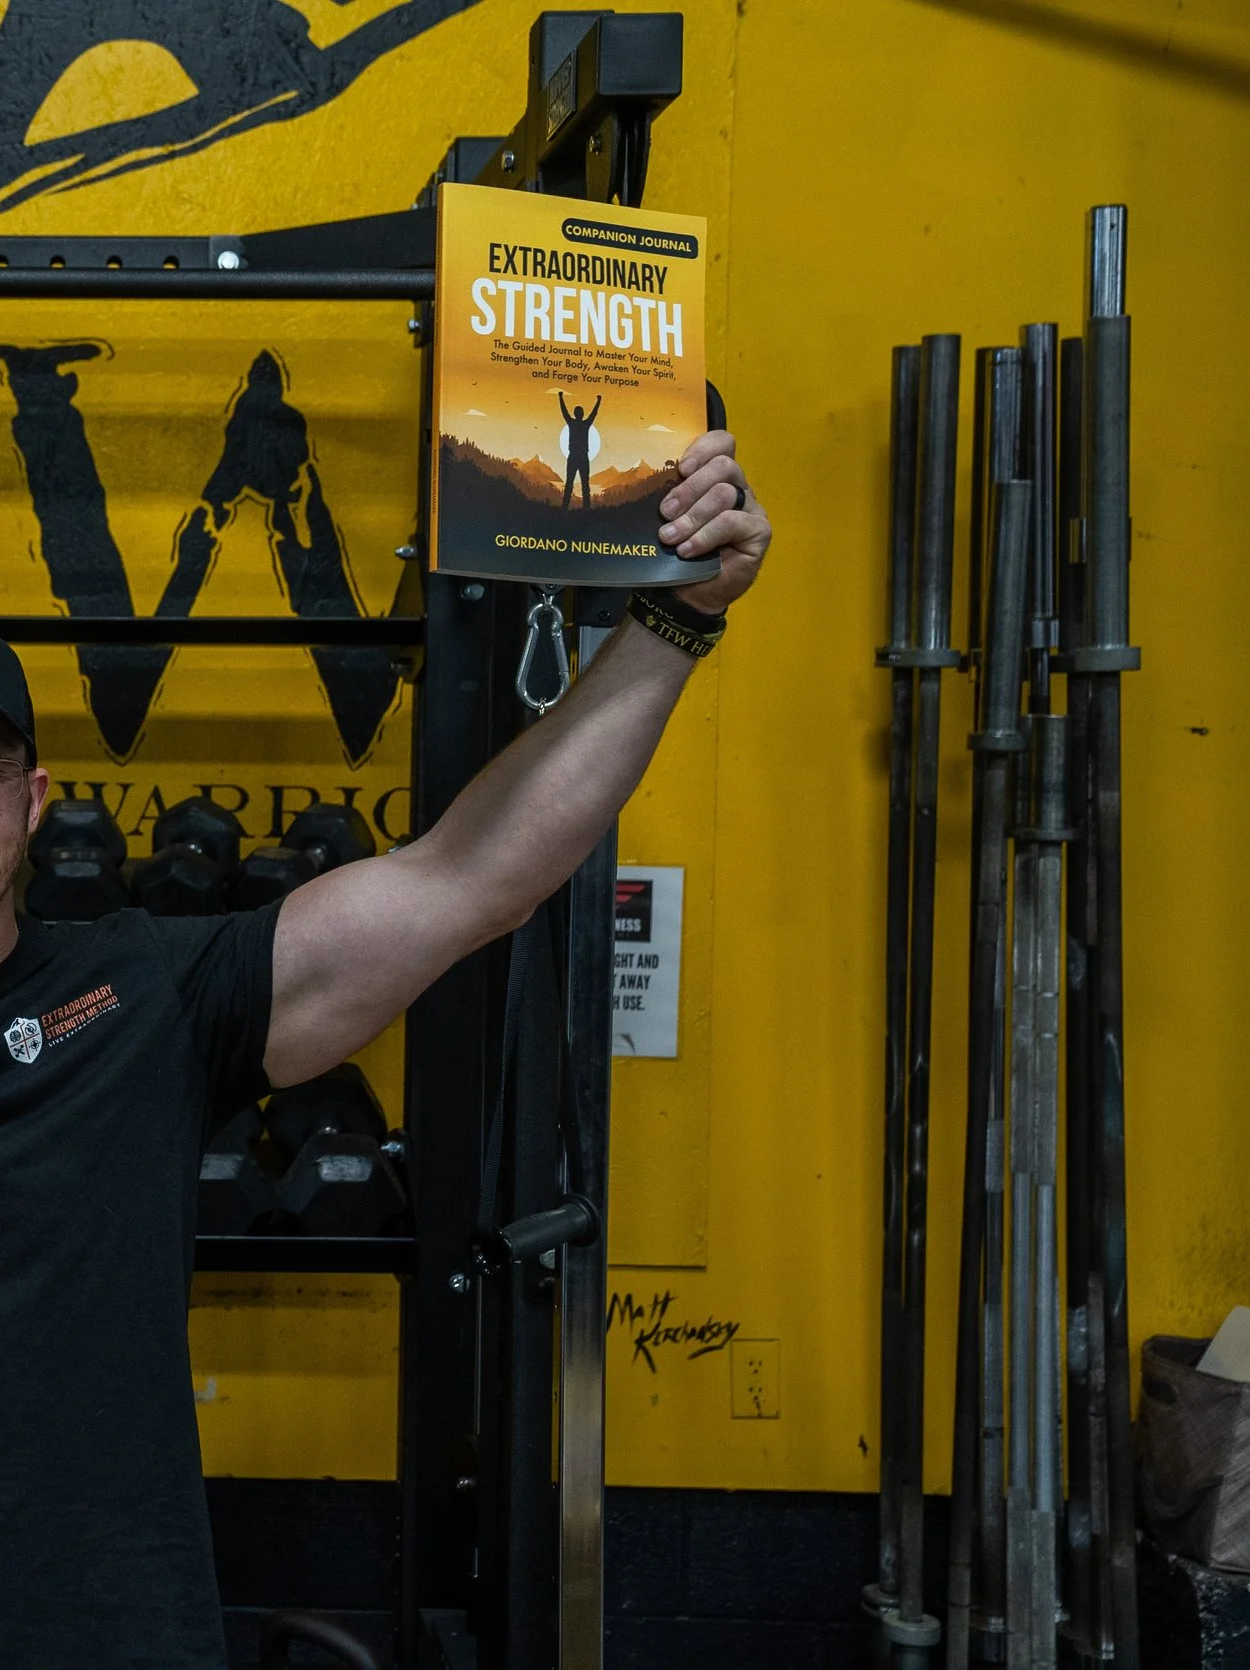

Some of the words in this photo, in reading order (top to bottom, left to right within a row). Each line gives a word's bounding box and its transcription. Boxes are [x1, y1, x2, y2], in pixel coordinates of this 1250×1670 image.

[565, 224, 636, 245] COMPANION
[639, 235, 692, 253] JOURNAL
[489, 243, 668, 295] EXTRAORDINARY
[470, 278, 683, 357] STRENGTH
[490, 352, 539, 366] Strengthen
[542, 357, 562, 368] Your
[565, 358, 590, 371] Body,
[593, 361, 629, 374] Awaken
[631, 365, 651, 376] Your
[653, 368, 677, 381] Spirit,
[493, 339, 510, 350] The
[512, 342, 546, 354] Guided
[548, 344, 581, 357] Journal
[584, 348, 593, 358] to
[596, 349, 626, 361] Master
[628, 352, 648, 363] Your
[650, 356, 673, 368] Mind,
[532, 370, 550, 379] and
[552, 371, 579, 382] Forge
[581, 372, 602, 383] Your
[605, 374, 640, 387] Purpose
[495, 534, 567, 552] GIORDANO
[571, 541, 657, 558] NUNEMAKER
[658, 621, 692, 647] TFW
[638, 954, 659, 969] AND
[619, 975, 651, 990] AWAY
[41, 984, 113, 1027] EXTRAORDINARY
[622, 995, 645, 1011] USE.
[45, 1012, 86, 1040] STRENGTH
[86, 995, 118, 1019] METHOD
[48, 1036, 65, 1047] LIVE
